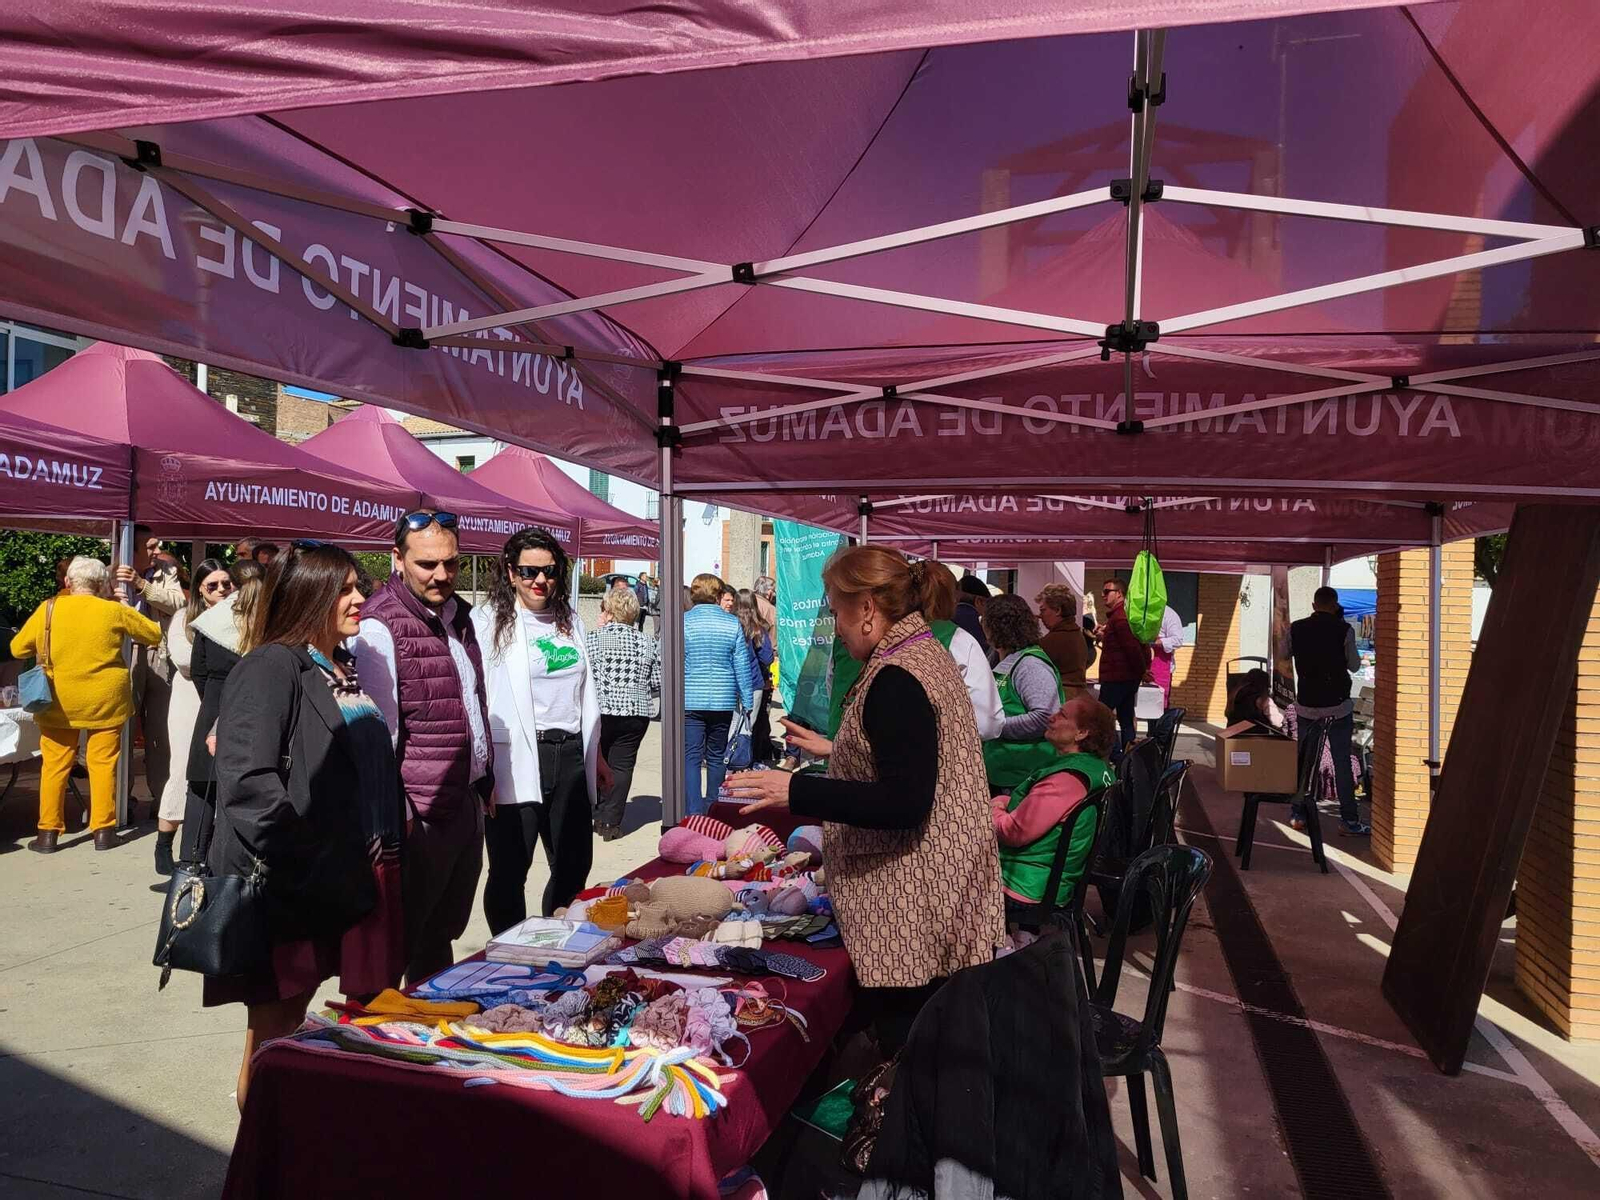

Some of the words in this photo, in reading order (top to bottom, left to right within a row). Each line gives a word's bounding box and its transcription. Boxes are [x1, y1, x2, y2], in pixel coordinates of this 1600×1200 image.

[0, 453, 104, 489] ADAMUZ
[204, 480, 328, 511] AYUNTAMIENTO
[331, 496, 350, 515] DE
[352, 499, 406, 523] ADAMUZ
[458, 515, 526, 536] AYUNTAMIENTO
